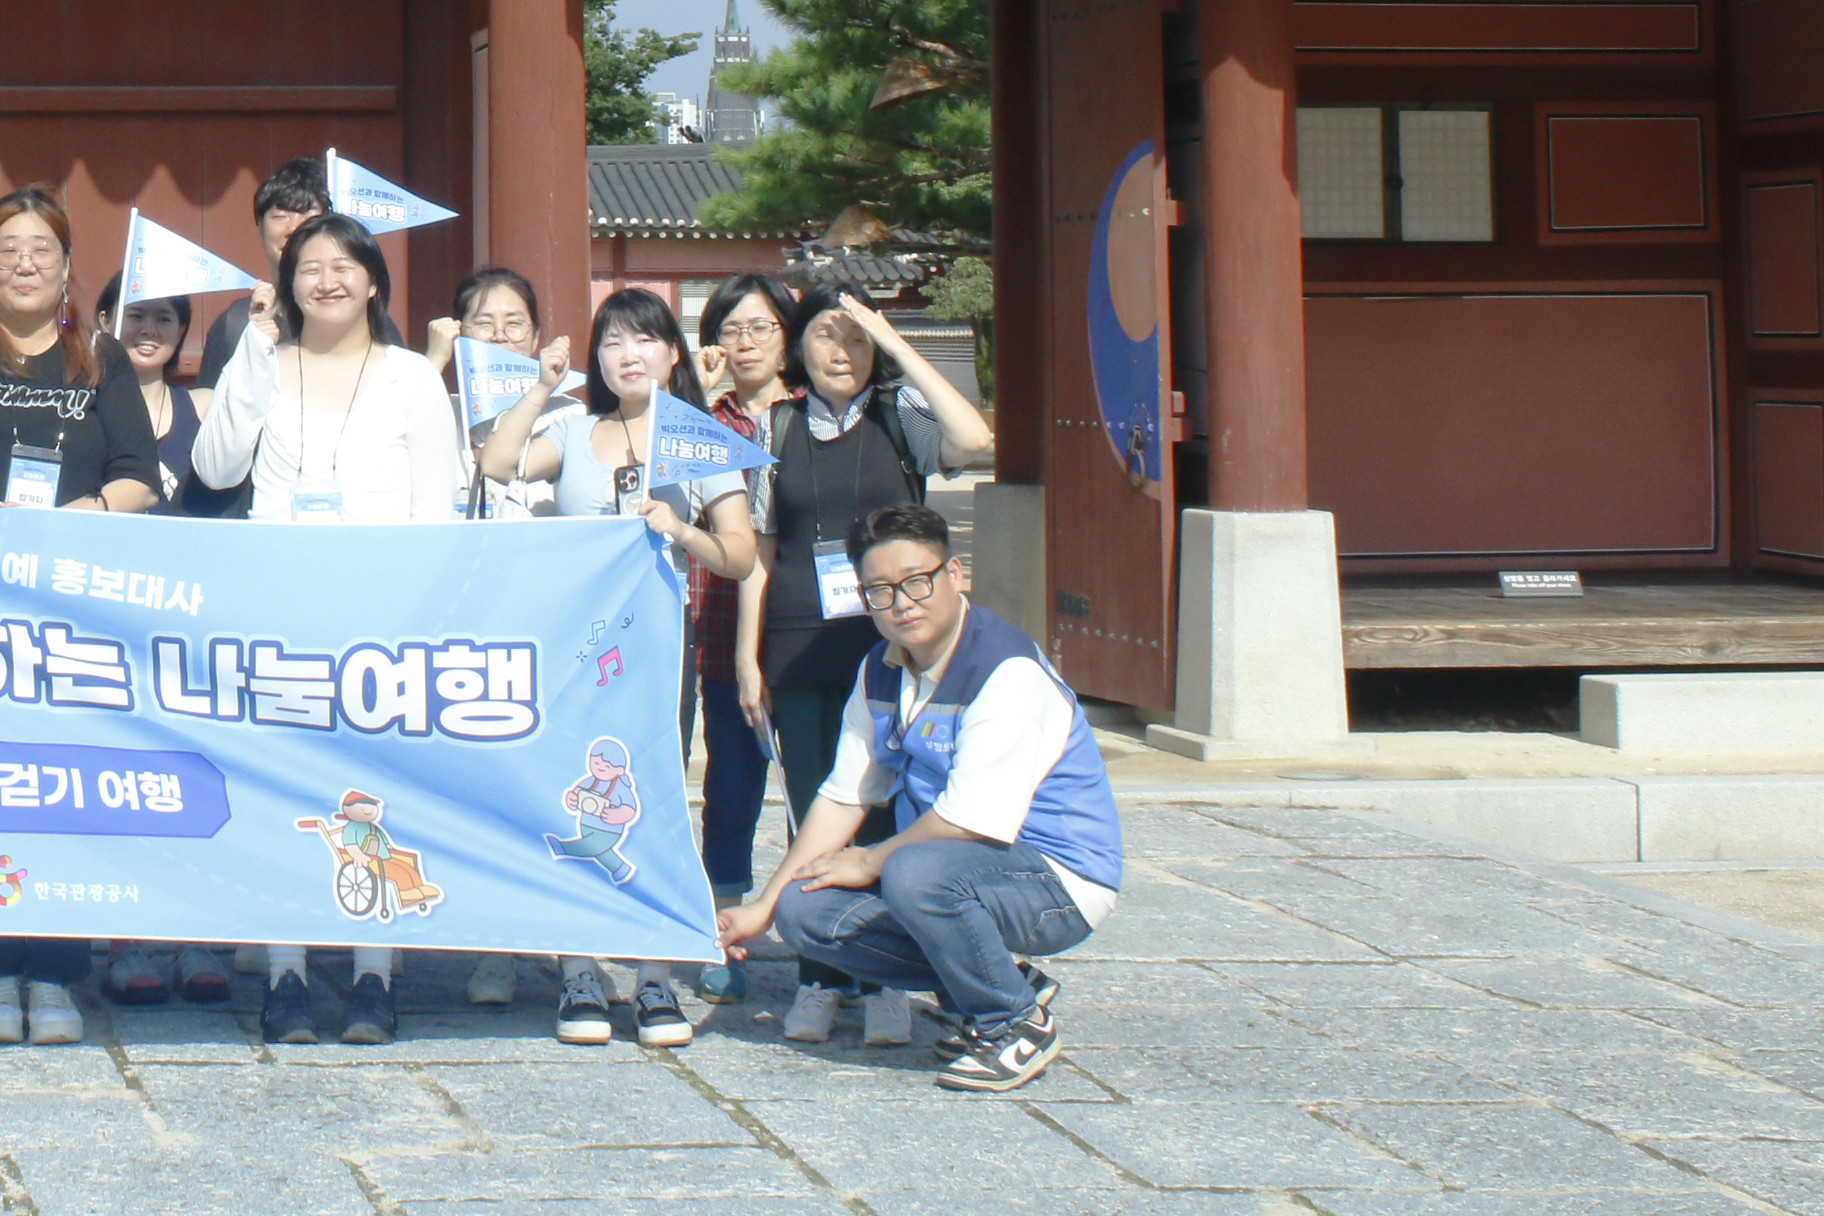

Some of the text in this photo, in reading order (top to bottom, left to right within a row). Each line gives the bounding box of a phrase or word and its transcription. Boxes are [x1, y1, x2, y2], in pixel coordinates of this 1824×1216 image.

[661, 424, 728, 444] 빅오션과 함께하는
[658, 436, 730, 466] 나눔여행
[19, 493, 44, 504] 참가자
[50, 557, 204, 616] 홍보대사
[151, 636, 540, 741] 나눔여행
[97, 769, 185, 814] 여행
[33, 881, 141, 904] 한국관광공사
